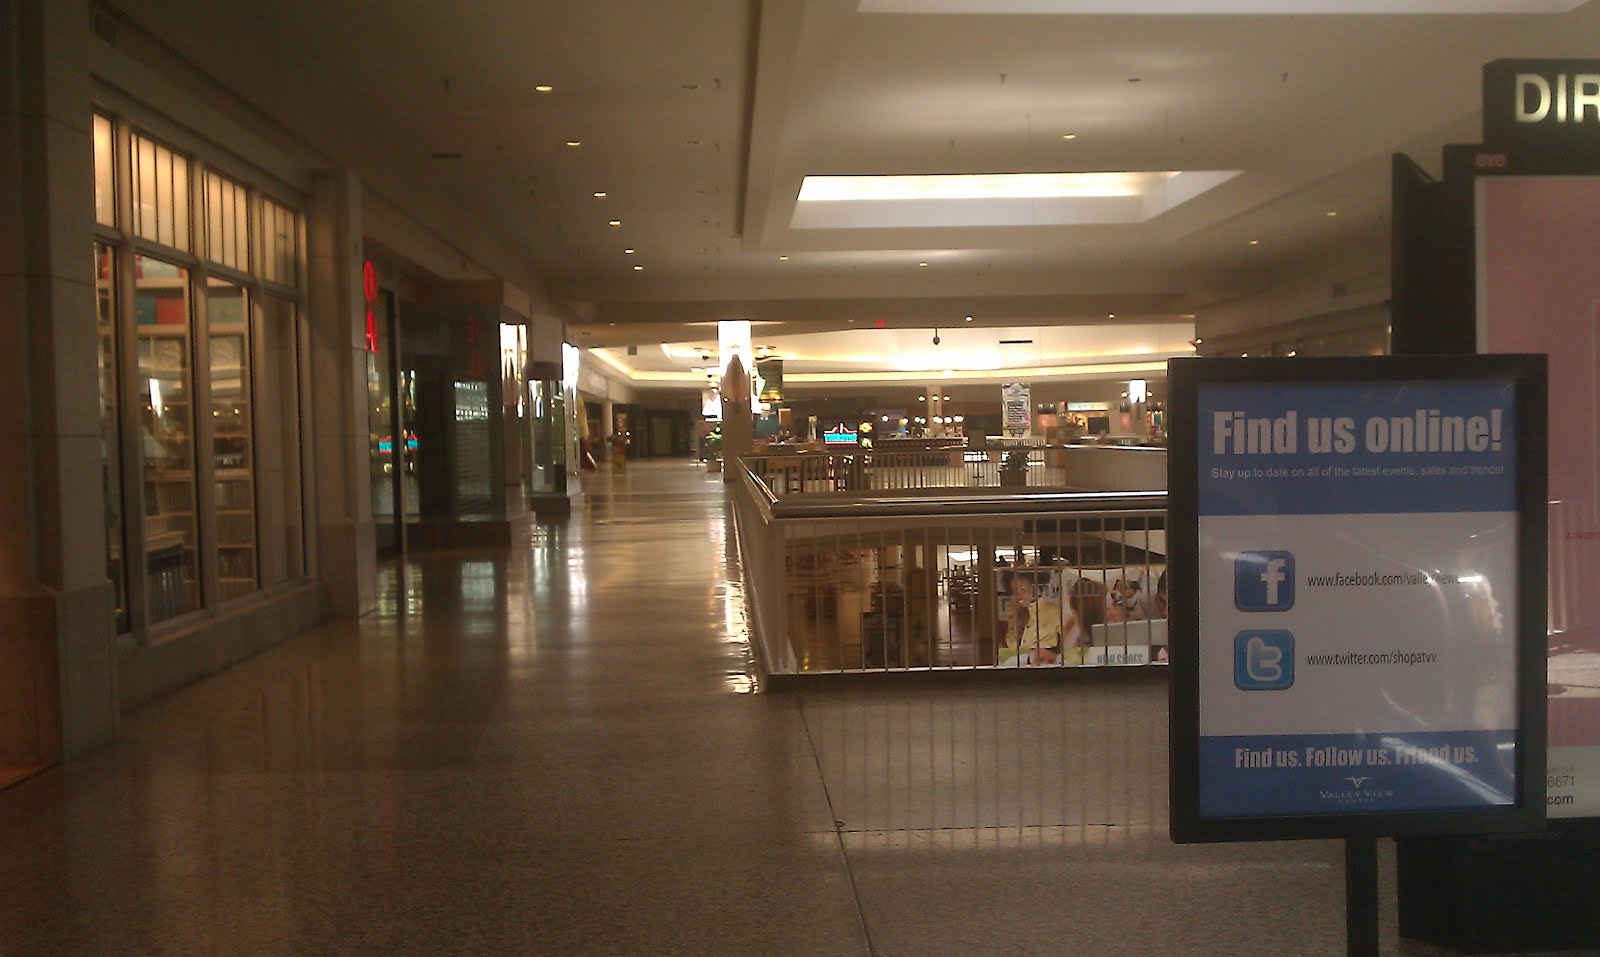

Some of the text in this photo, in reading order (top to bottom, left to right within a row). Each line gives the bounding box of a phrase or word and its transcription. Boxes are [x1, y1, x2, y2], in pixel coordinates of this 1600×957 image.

[1515, 73, 1600, 123] DIR
[1213, 409, 1503, 455] Find us online!
[1211, 467, 1235, 480] Stay
[1237, 469, 1251, 480] up
[1253, 467, 1263, 478] to
[1266, 467, 1288, 477] date
[1291, 468, 1305, 478] on
[1307, 466, 1319, 477] all
[1321, 466, 1332, 477] of
[1334, 466, 1350, 477] the
[1352, 466, 1381, 476] latest
[1420, 466, 1446, 476] sales
[1449, 465, 1468, 476] and
[1307, 650, 1437, 666] www.twitter.com/shopatvv
[1235, 748, 1272, 769] Find
[1276, 750, 1302, 768] us.
[1305, 747, 1363, 767] Follow
[1366, 749, 1392, 766] us.
[1453, 746, 1479, 764] us.
